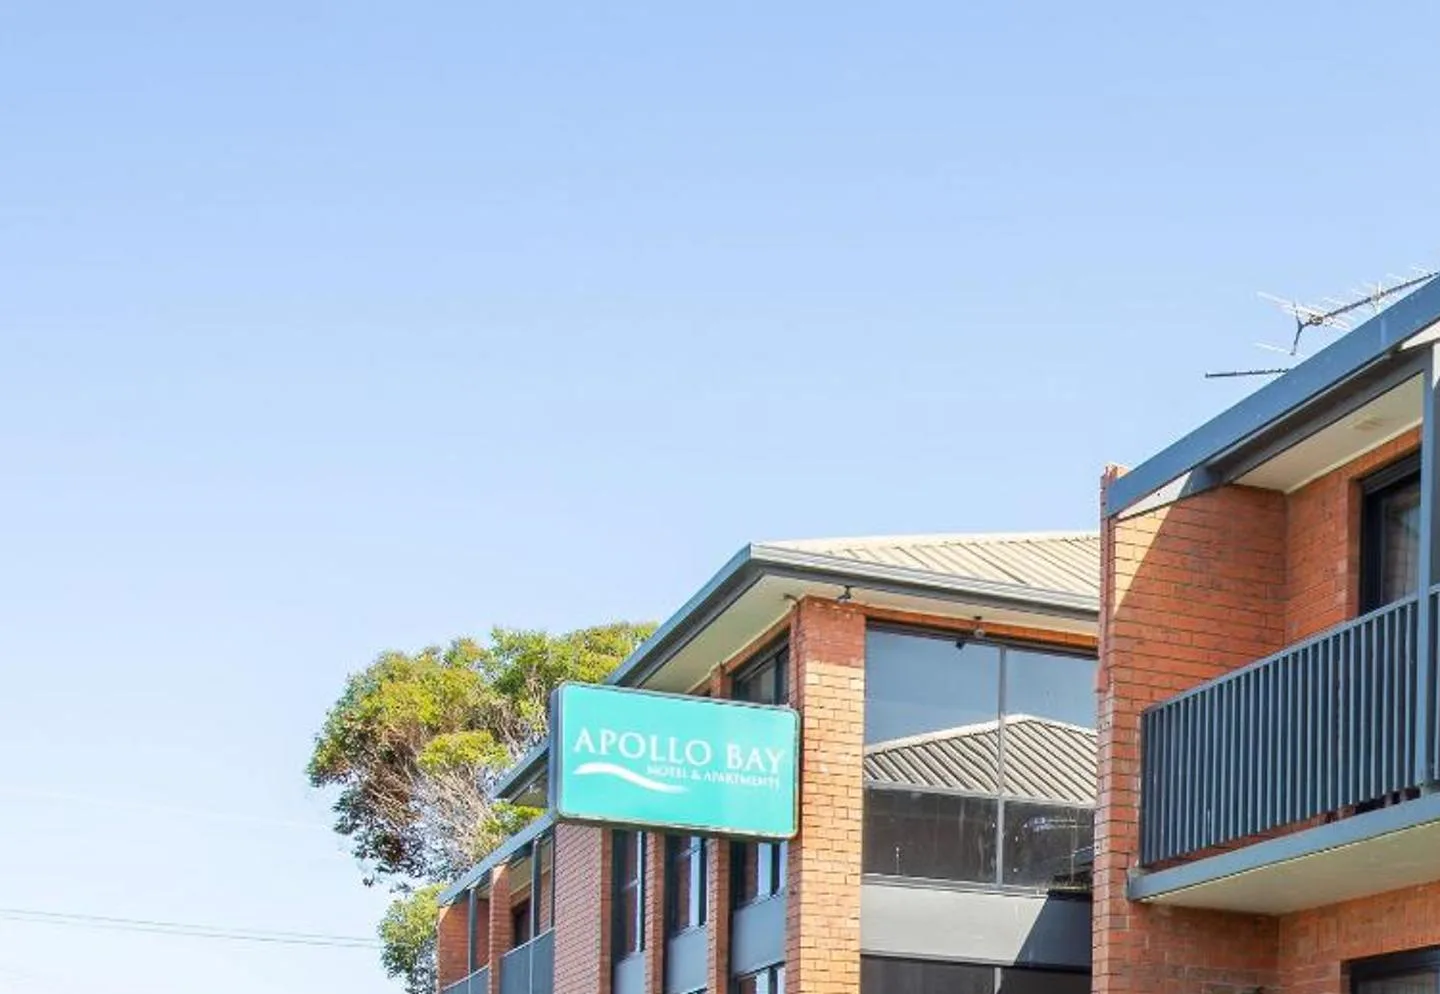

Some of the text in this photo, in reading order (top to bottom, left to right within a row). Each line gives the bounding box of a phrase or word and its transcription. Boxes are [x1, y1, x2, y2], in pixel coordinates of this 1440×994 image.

[573, 727, 786, 773] APOLLO BAY
[691, 769, 701, 781] &
